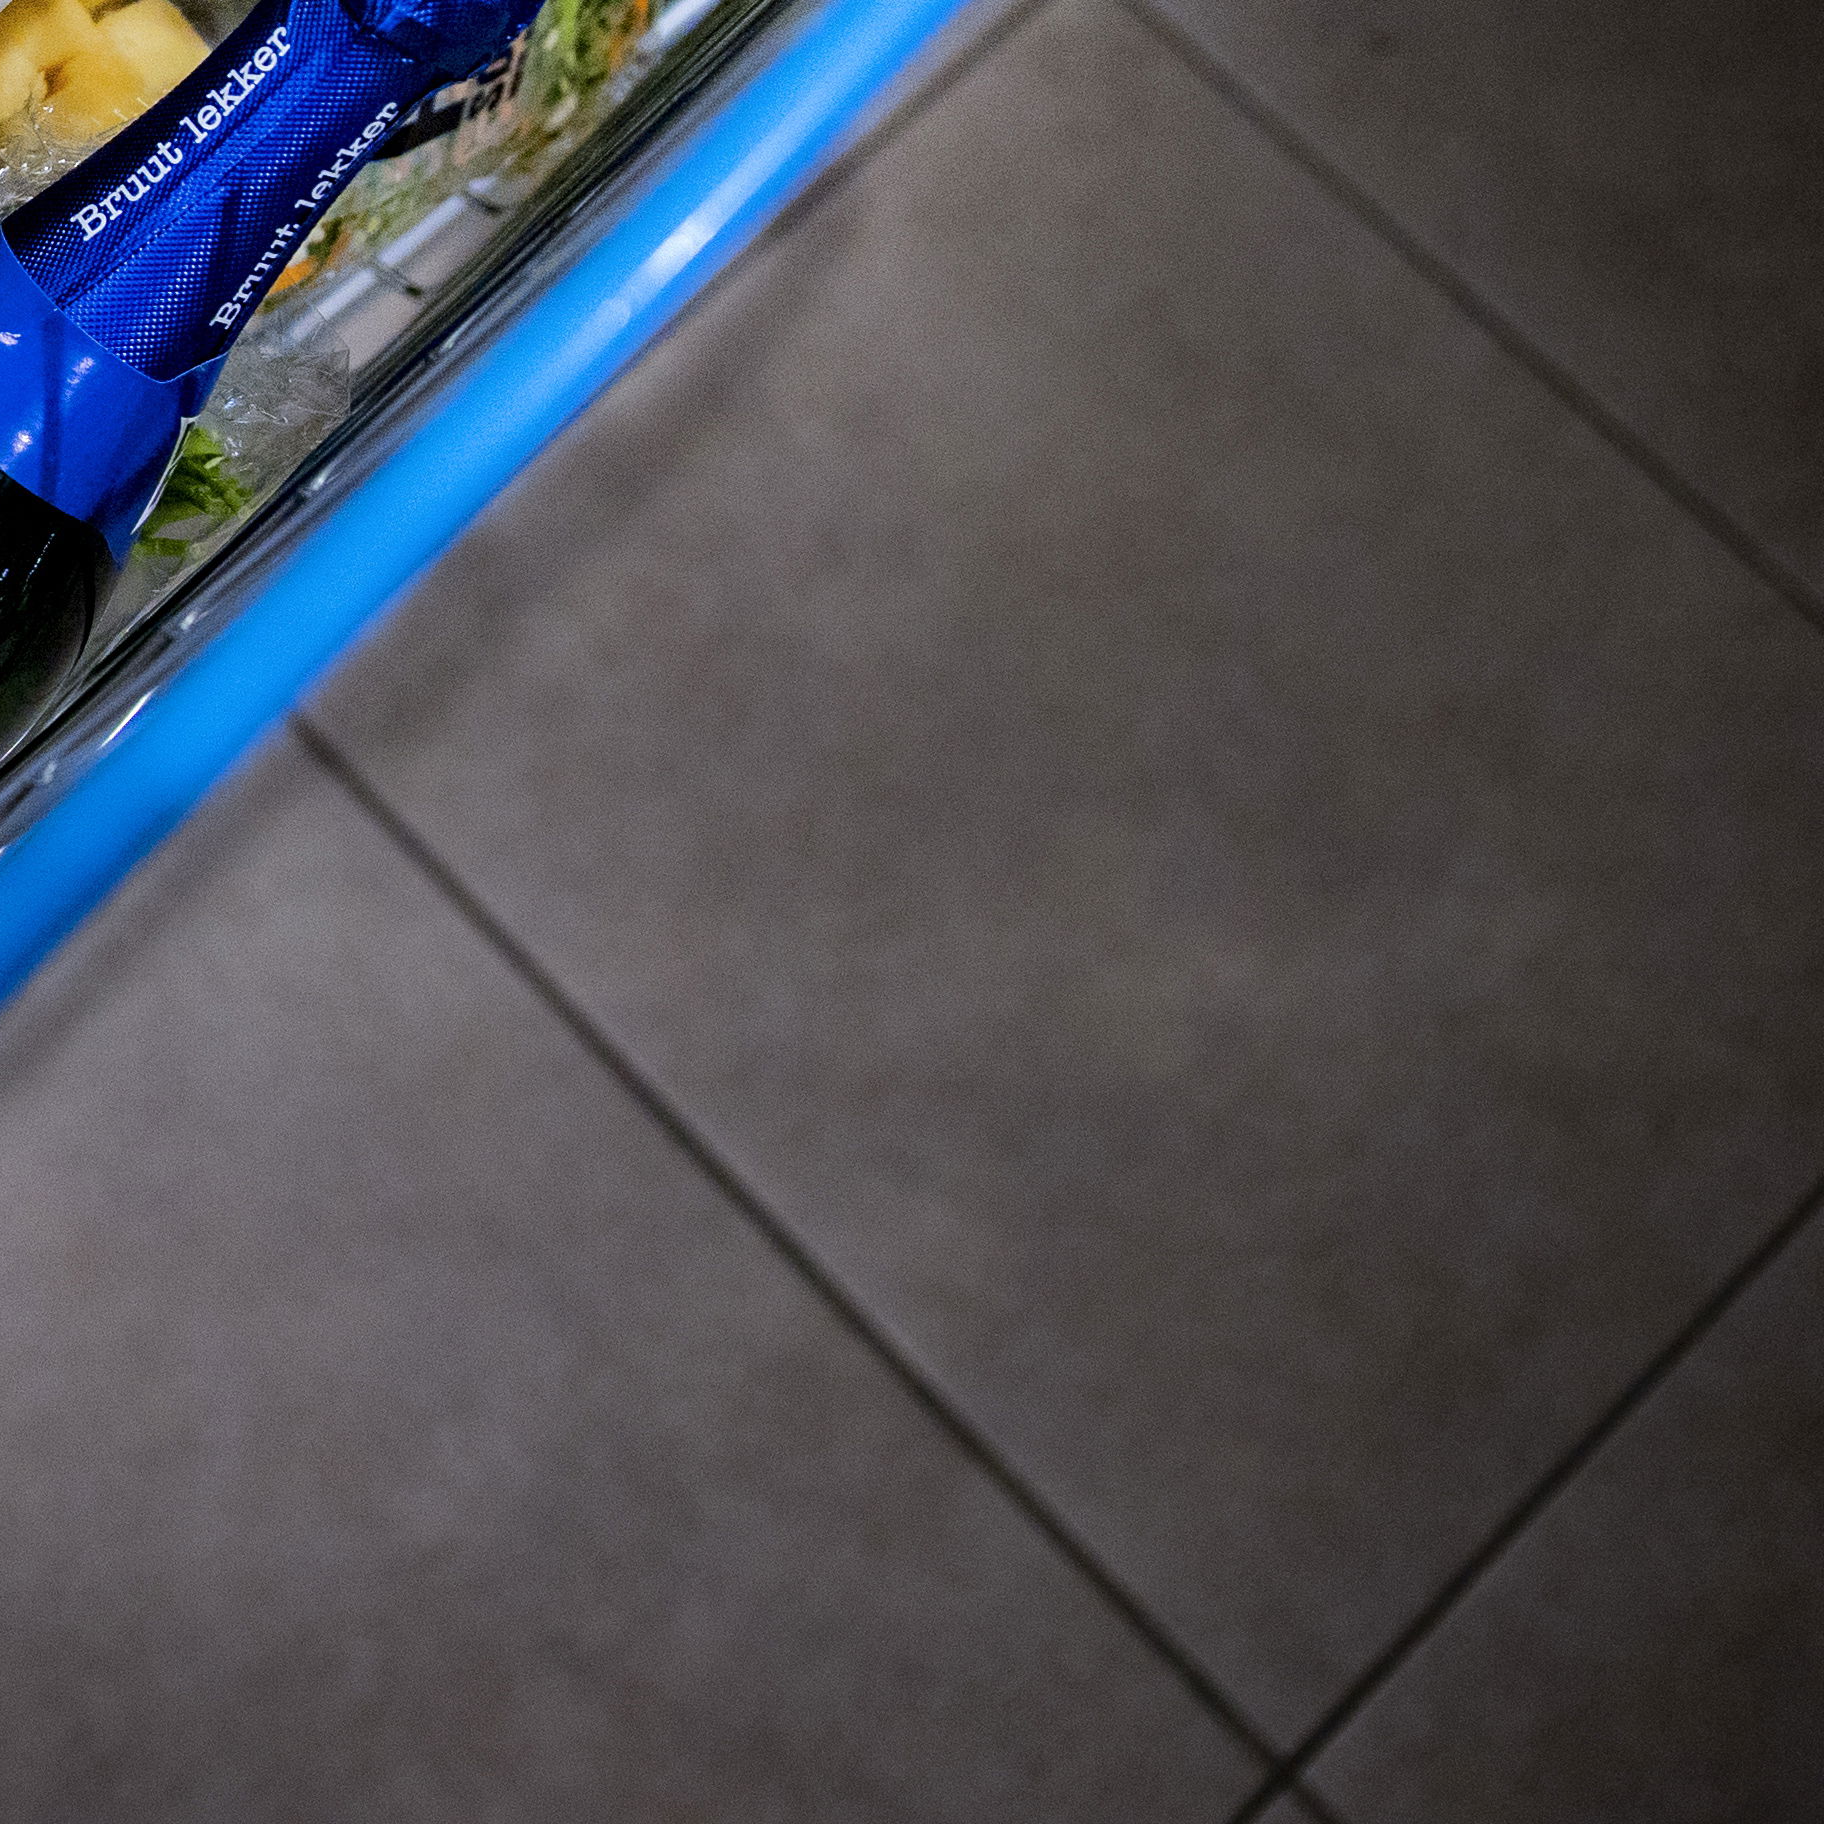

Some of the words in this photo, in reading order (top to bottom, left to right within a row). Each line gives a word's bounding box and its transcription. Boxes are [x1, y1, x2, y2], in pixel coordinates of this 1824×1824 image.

[69, 140, 185, 243] Bruut
[178, 25, 293, 145] lekker
[295, 100, 402, 224] lekker
